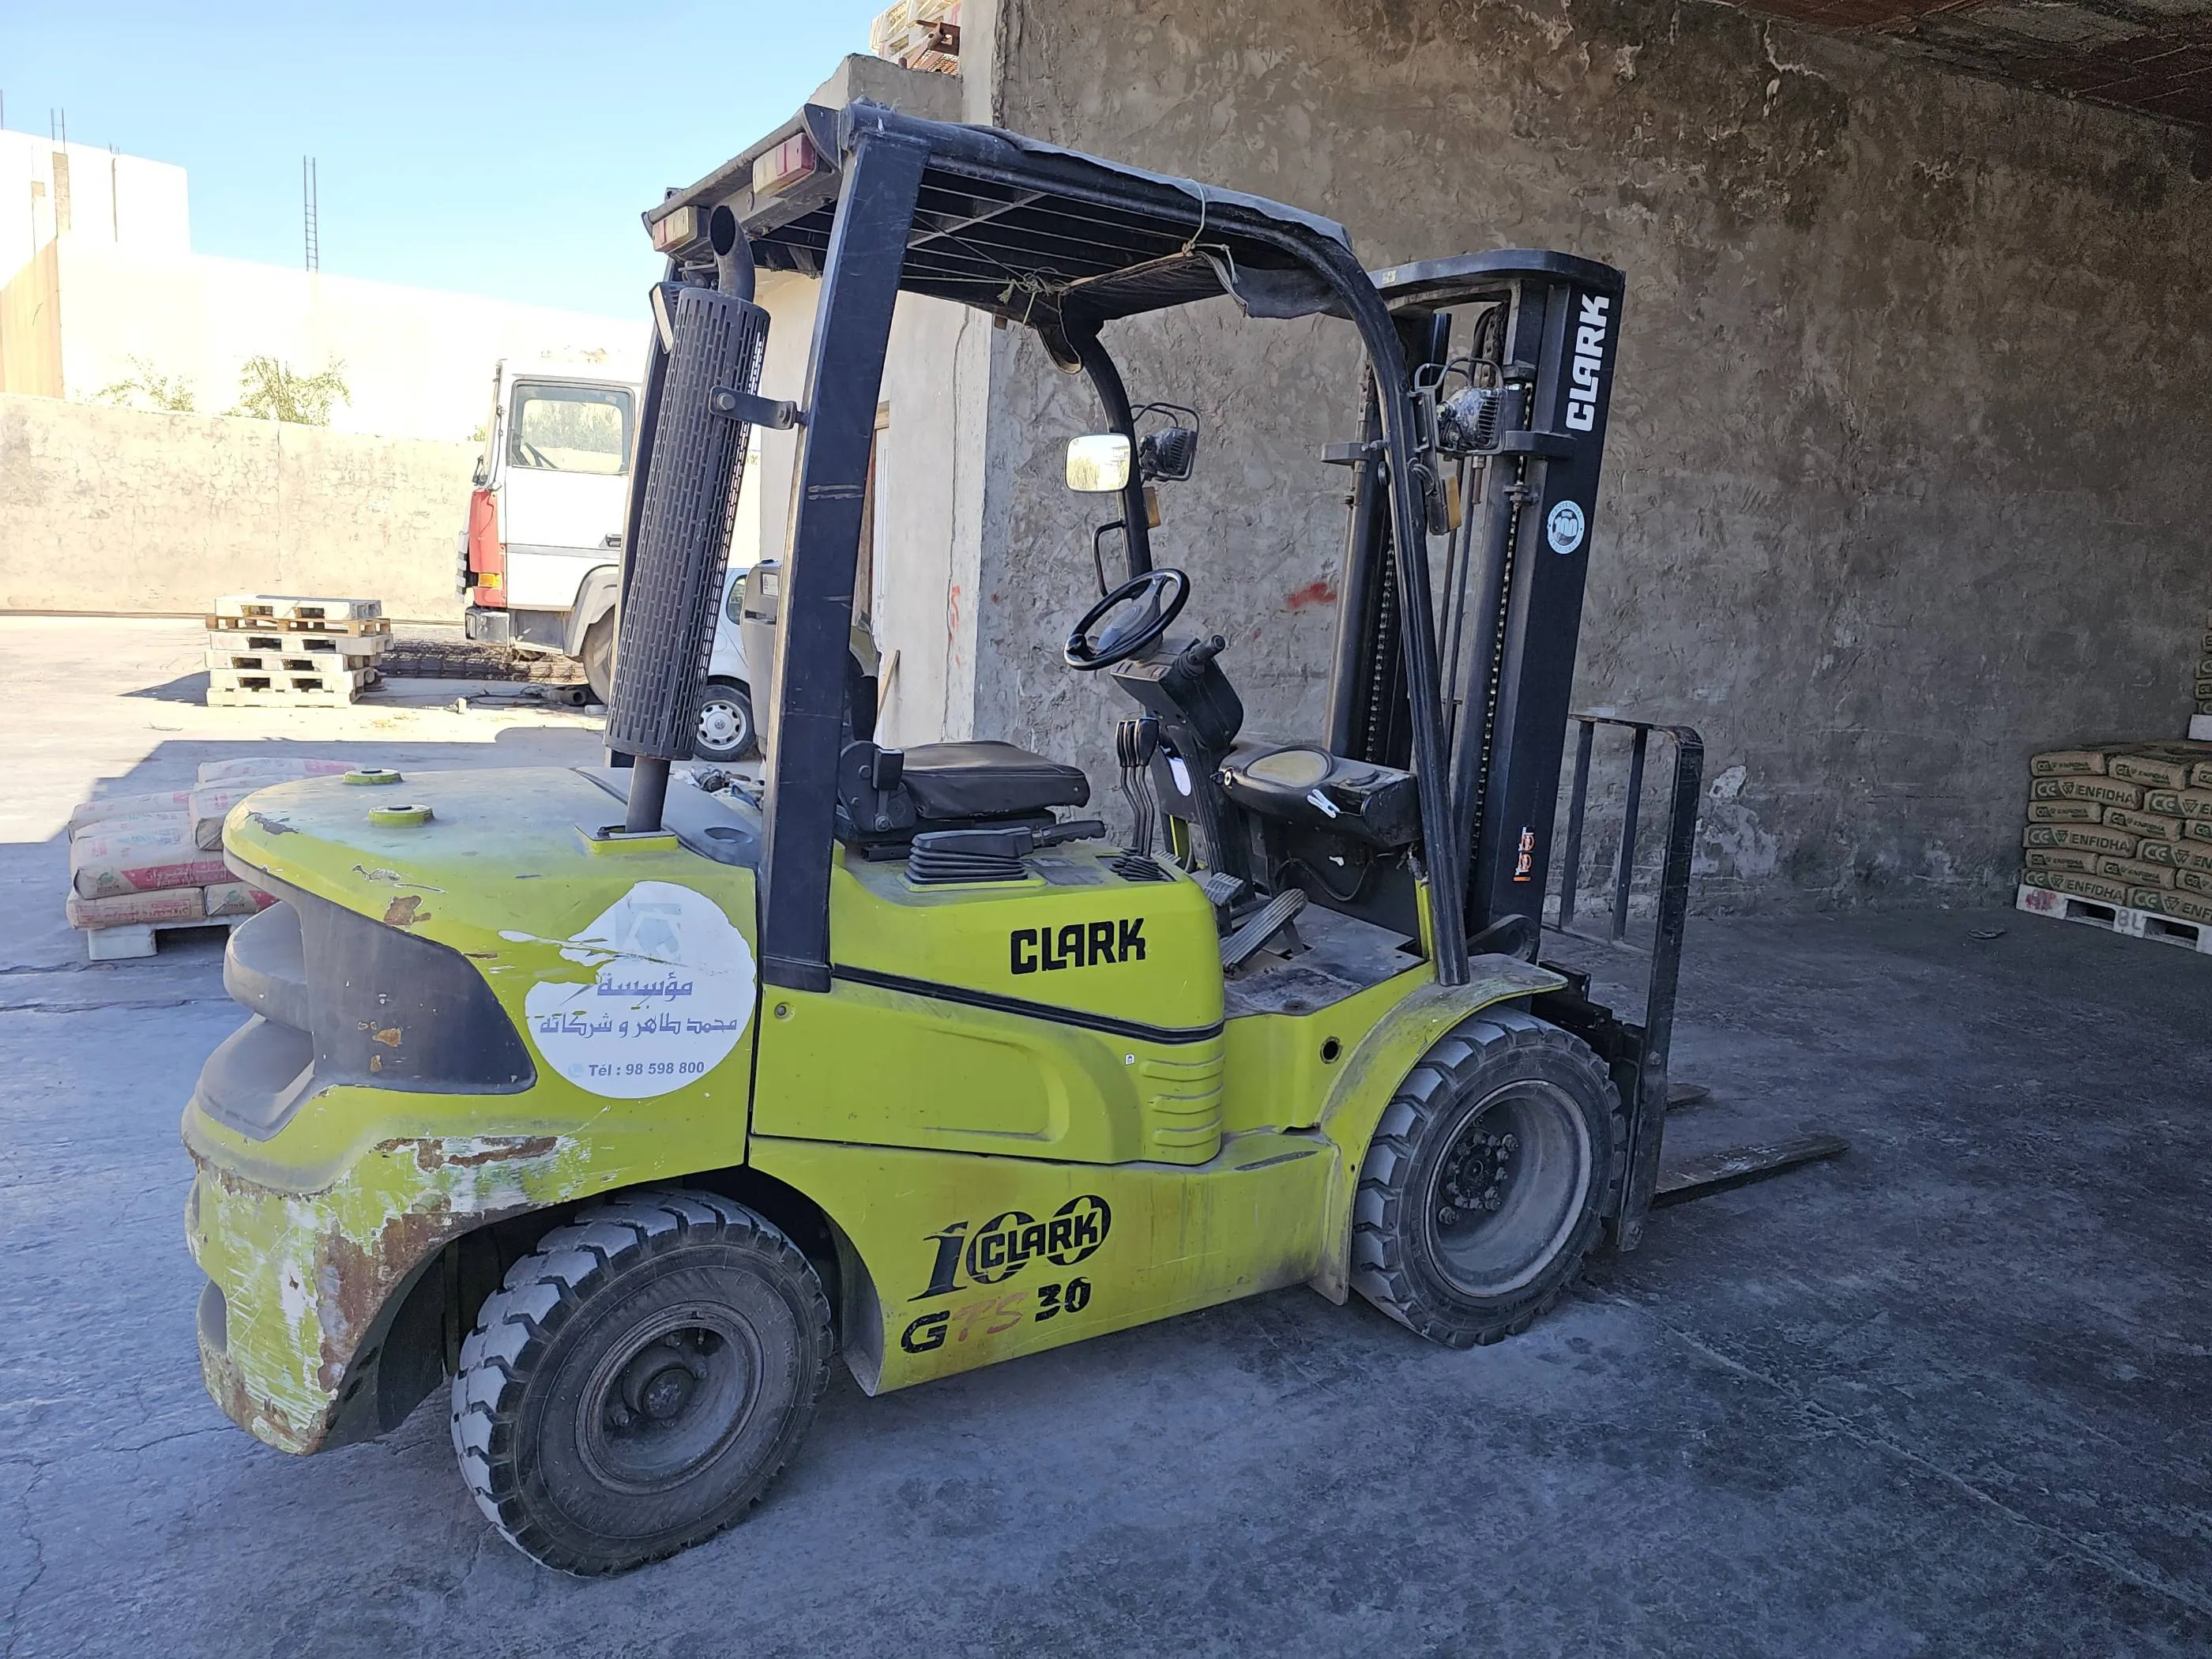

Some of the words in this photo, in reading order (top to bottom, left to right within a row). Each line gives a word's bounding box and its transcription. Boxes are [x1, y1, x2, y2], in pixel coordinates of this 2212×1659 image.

[1566, 293, 1609, 431] CLARK
[2078, 784, 2135, 803] ENFIDHA
[2071, 833, 2130, 852] ENFIDHA
[2067, 881, 2122, 901] ENFIDHA
[1011, 918, 1146, 975] CLARK
[597, 971, 693, 1002] مؤسسة
[631, 1012, 681, 1038] طاهر
[686, 1018, 738, 1034] محمد
[588, 1063, 612, 1077] Tél
[625, 1063, 643, 1075] 98
[648, 1063, 674, 1074] 598
[679, 1061, 705, 1074] 800
[981, 1211, 1098, 1270] CLARK
[1034, 1276, 1092, 1323] 30
